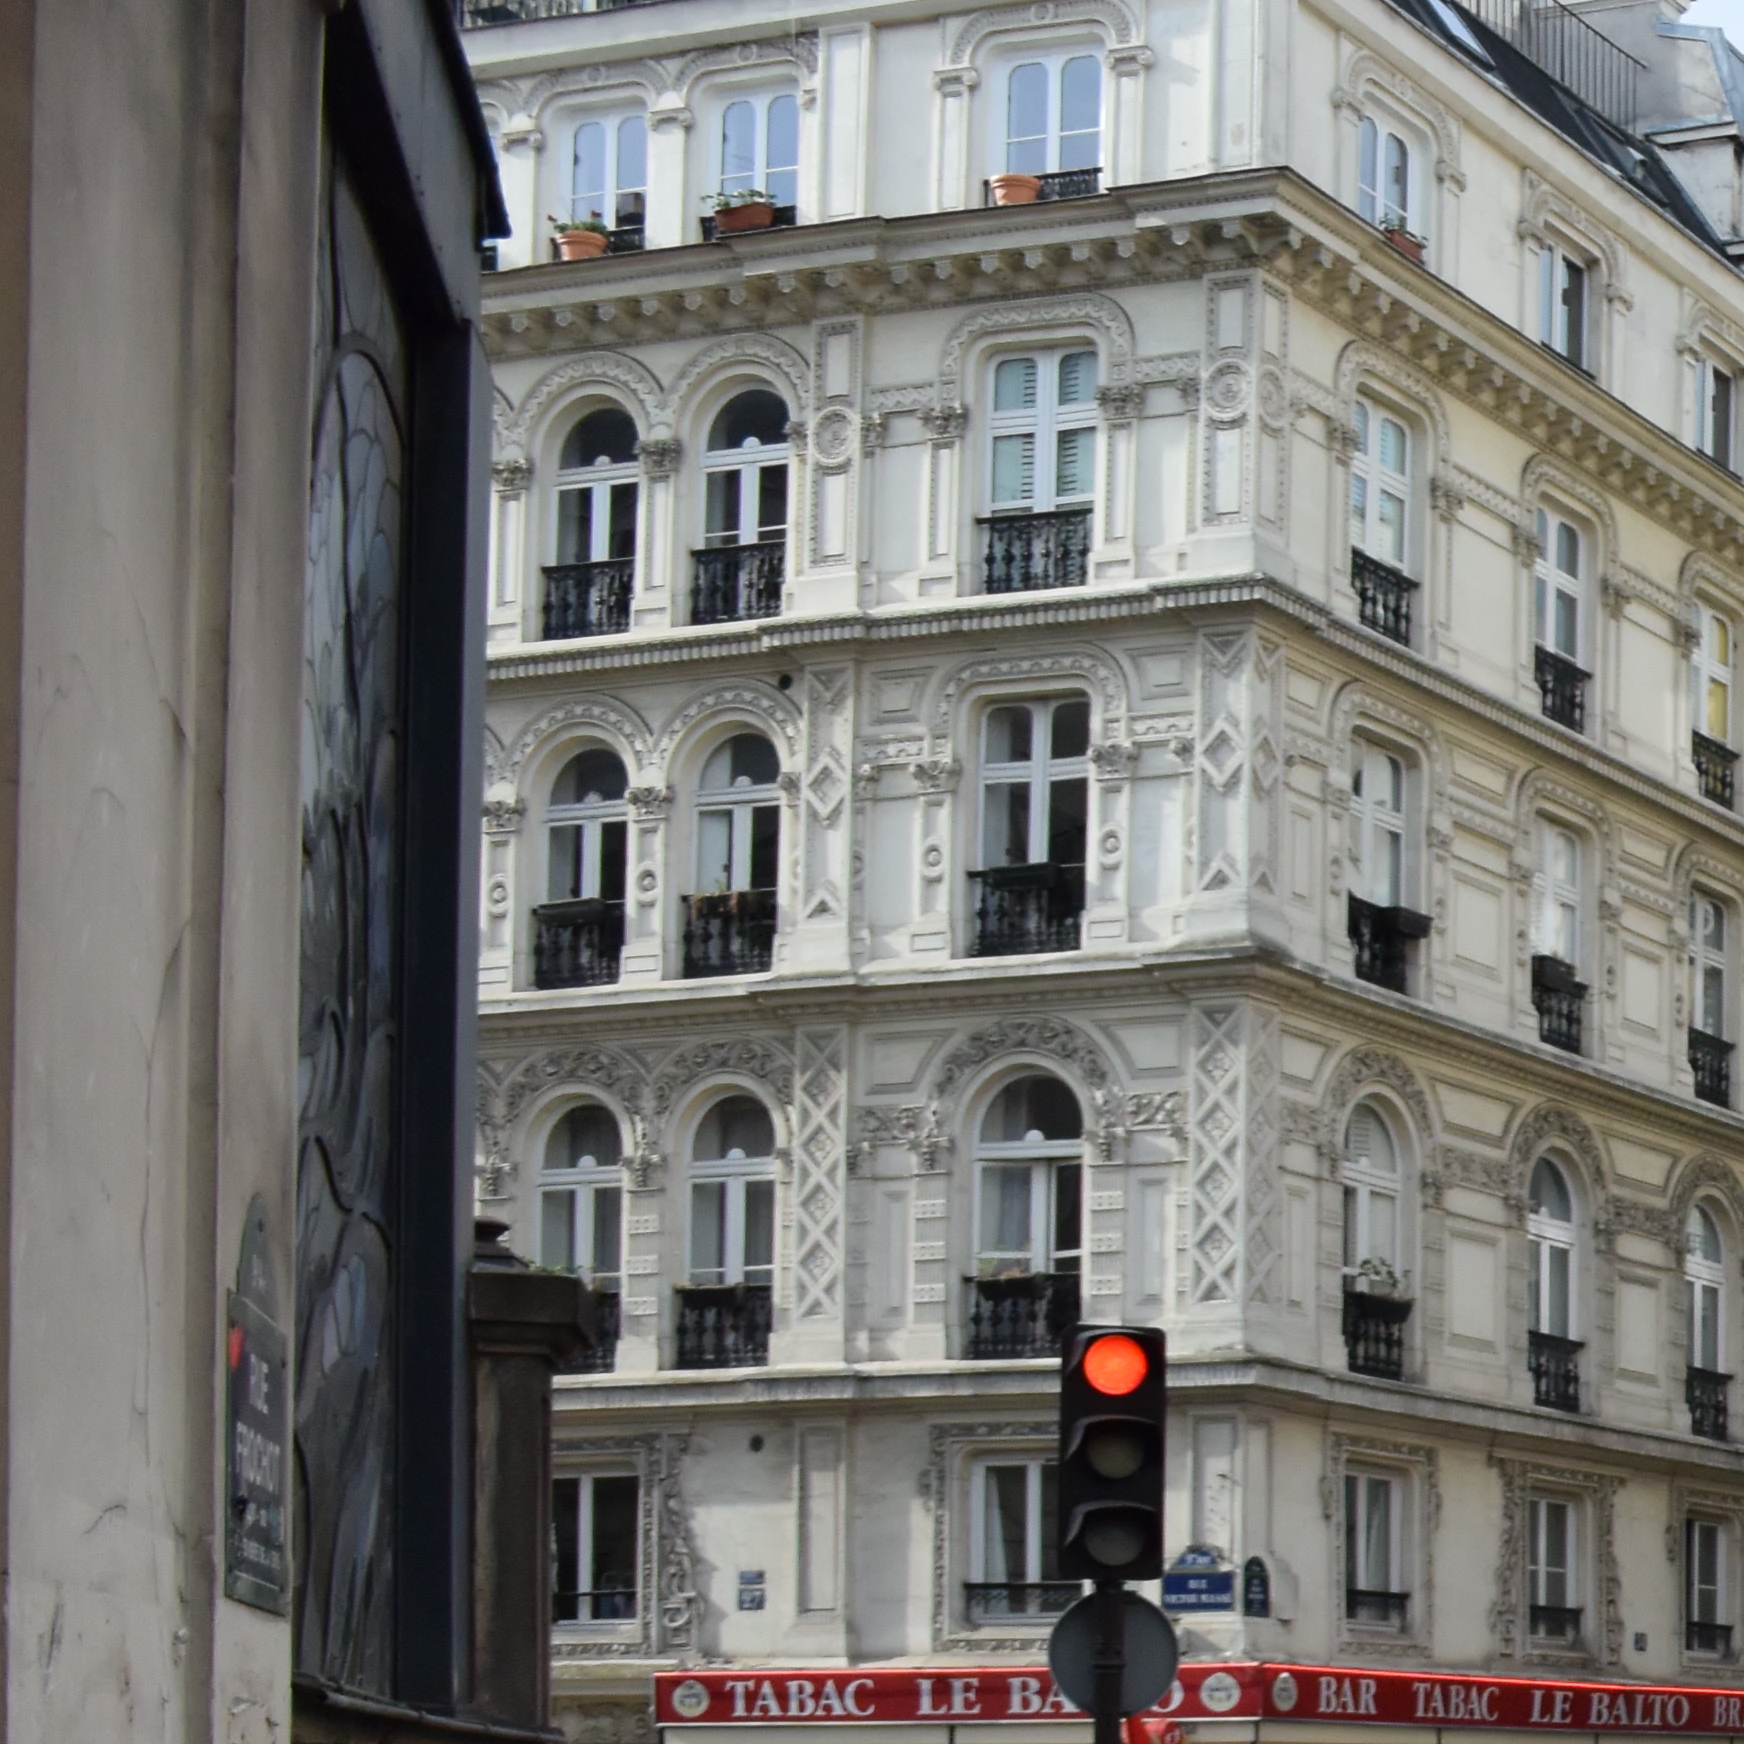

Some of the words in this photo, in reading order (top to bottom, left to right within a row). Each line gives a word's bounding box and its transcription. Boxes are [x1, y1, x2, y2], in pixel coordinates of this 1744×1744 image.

[249, 1353, 270, 1414] RUE
[724, 1678, 875, 1719] TABAC
[916, 1677, 982, 1716] LE
[1007, 1676, 1185, 1717] BAO
[1317, 1676, 1379, 1716] BAR
[1412, 1681, 1500, 1723] TABAC
[1529, 1688, 1576, 1725] LE
[1588, 1691, 1691, 1728] BALTO
